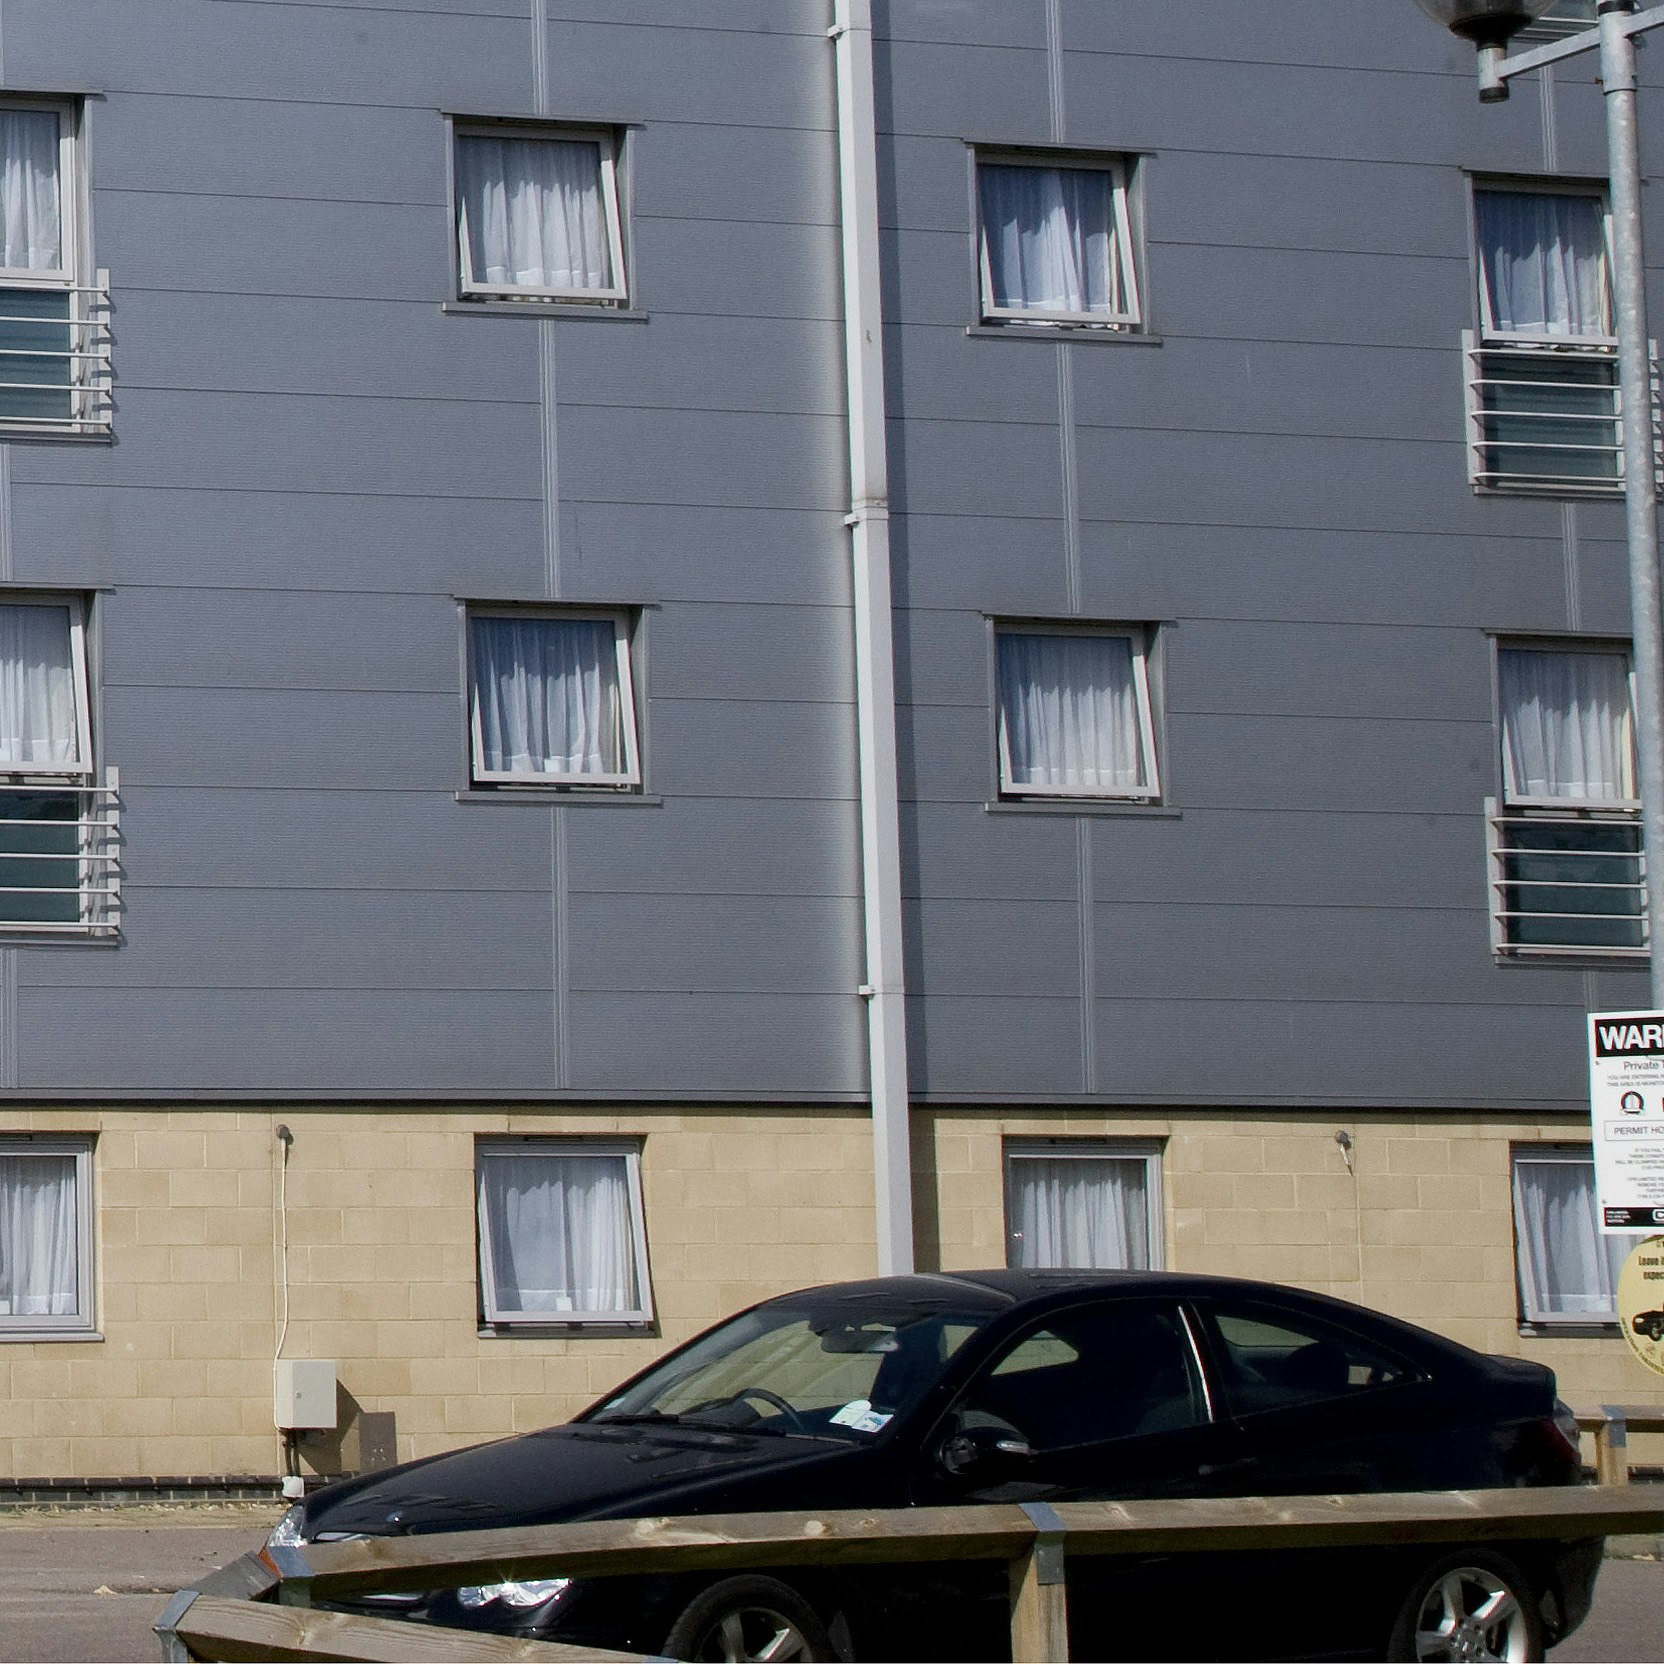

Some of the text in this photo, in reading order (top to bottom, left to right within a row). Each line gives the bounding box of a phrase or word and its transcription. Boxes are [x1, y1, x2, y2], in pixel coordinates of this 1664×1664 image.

[1598, 1024, 1664, 1051] WAR
[1623, 1061, 1660, 1071] Private
[1614, 1126, 1664, 1135] PERMIT HO
[1643, 1271, 1664, 1280] expec
